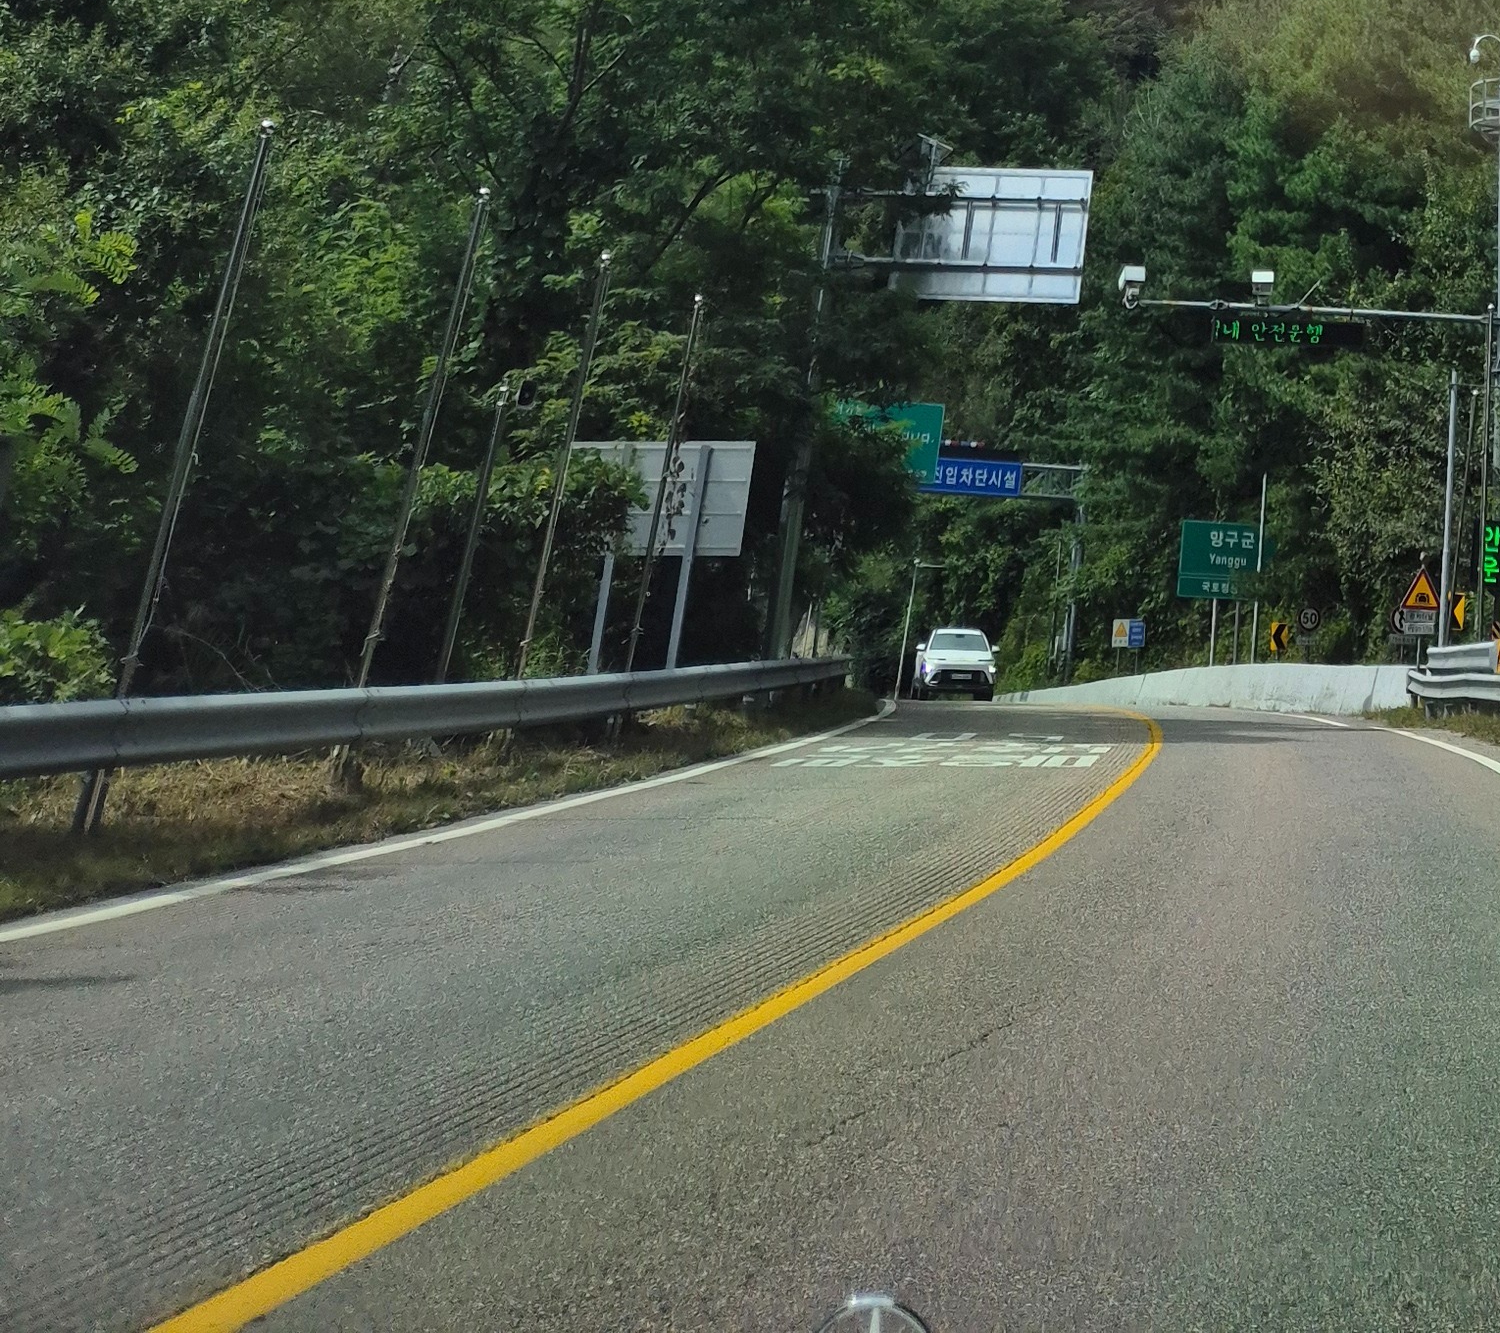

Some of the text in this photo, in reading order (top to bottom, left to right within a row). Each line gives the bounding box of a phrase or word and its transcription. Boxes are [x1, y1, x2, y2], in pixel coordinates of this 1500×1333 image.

[1251, 321, 1324, 344] 안전운행
[1210, 531, 1255, 549] 양구군
[1209, 553, 1247, 569] Yanggu
[1302, 612, 1317, 625] 50
